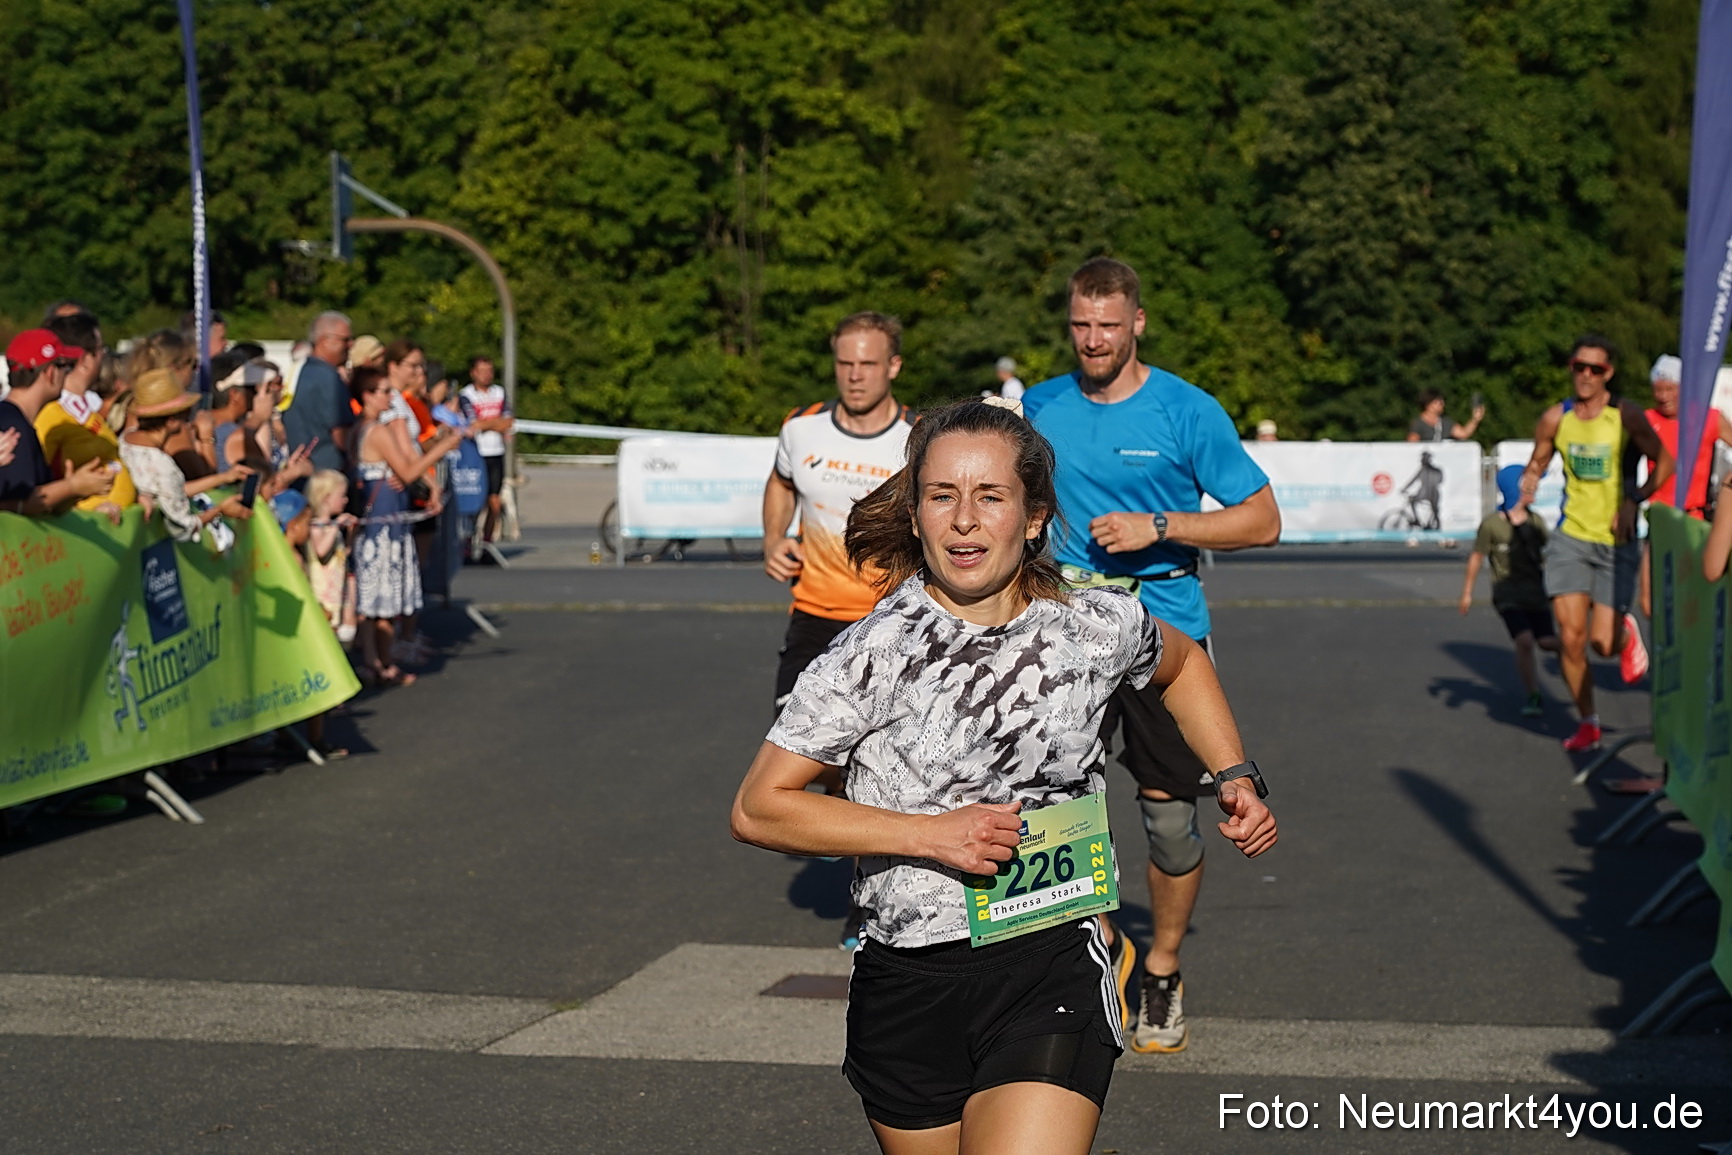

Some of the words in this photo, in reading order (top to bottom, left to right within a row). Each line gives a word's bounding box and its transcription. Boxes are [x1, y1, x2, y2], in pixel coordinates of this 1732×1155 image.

[1019, 838, 1046, 851] neumarkt
[1020, 829, 1046, 845] enlauf
[1004, 844, 1075, 899] 226
[1089, 841, 1109, 896] 2022
[993, 897, 1042, 916] Theresa
[1051, 884, 1082, 900] Stark
[1018, 914, 1039, 924] Services
[1038, 905, 1066, 918] Deutschland
[1065, 901, 1080, 911] GmbH
